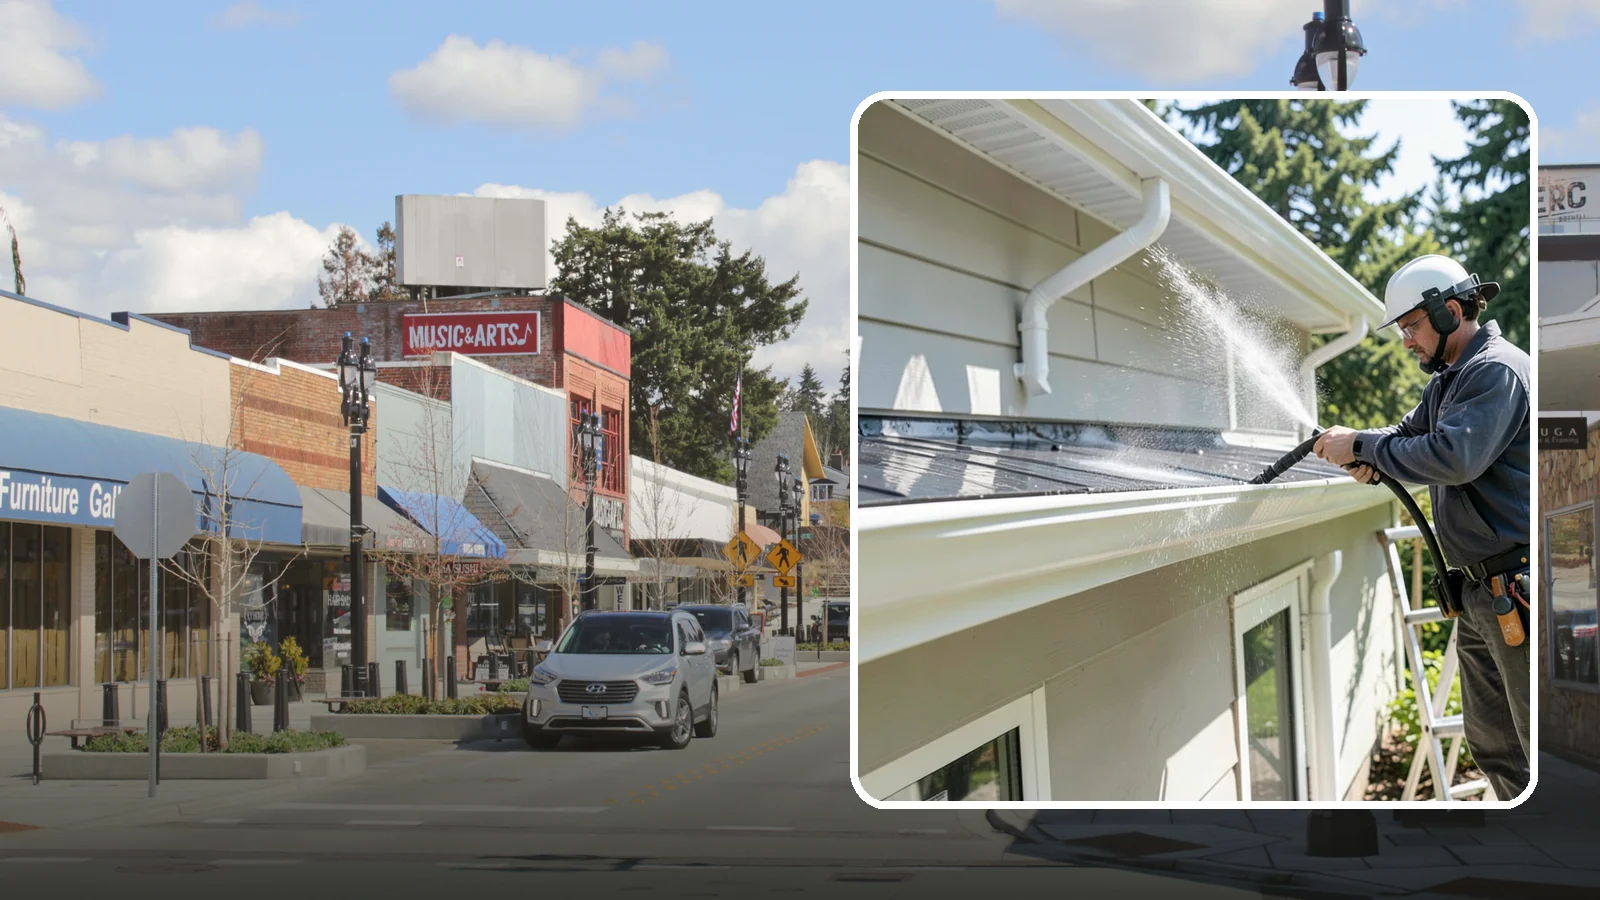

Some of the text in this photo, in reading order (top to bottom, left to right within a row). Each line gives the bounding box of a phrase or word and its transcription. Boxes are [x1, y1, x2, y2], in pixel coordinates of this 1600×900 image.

[409, 322, 520, 349] MUSIC&ARTS
[0, 471, 122, 519] Furniture Gal
[453, 562, 480, 574] SUSHI
